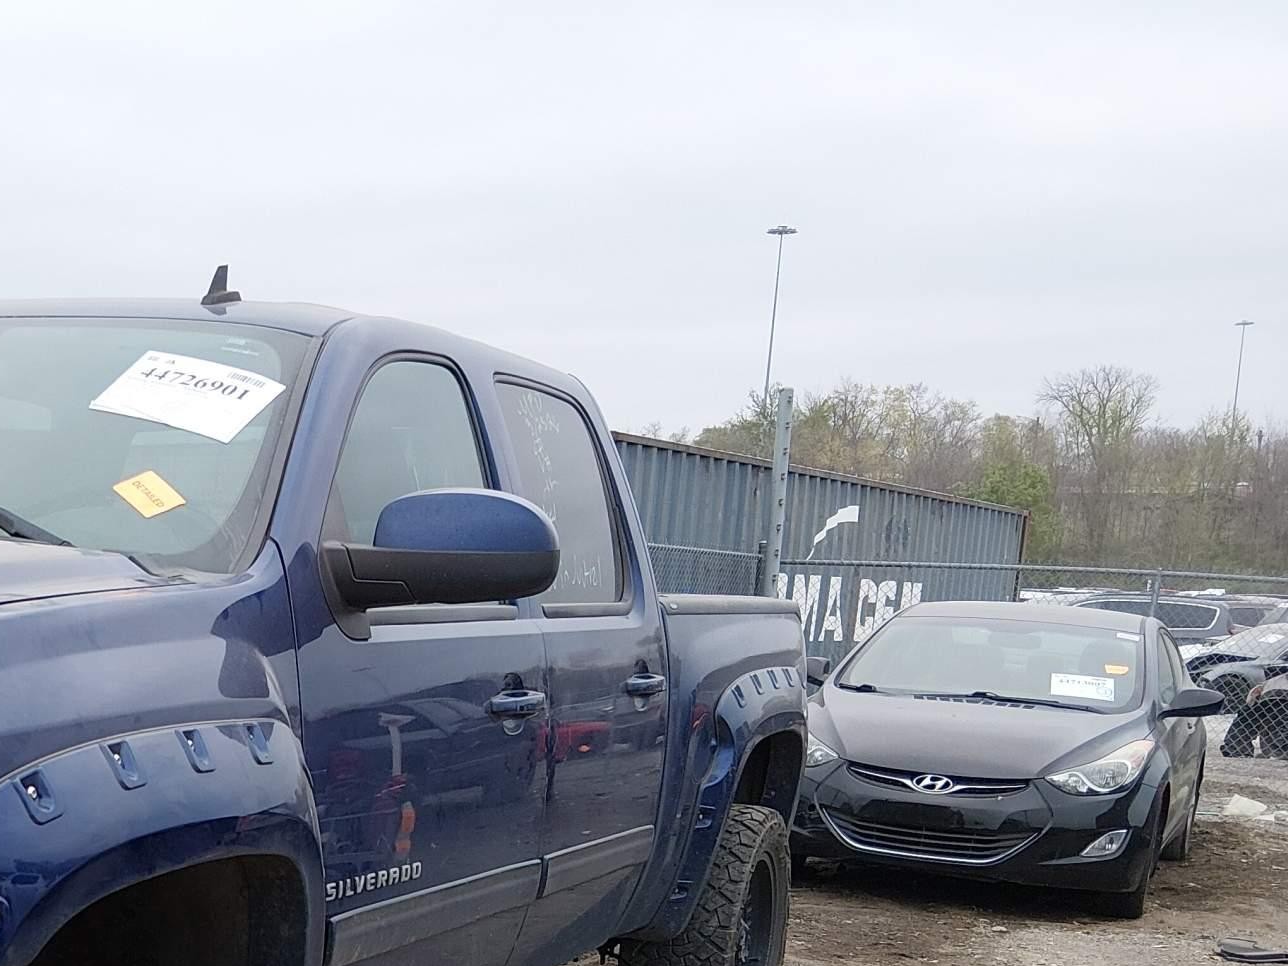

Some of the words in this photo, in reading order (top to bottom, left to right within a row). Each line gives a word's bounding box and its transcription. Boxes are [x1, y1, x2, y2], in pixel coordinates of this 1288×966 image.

[140, 367, 251, 400] 44726901
[132, 480, 165, 508] DETAILED
[325, 861, 422, 901] SILVERADO
